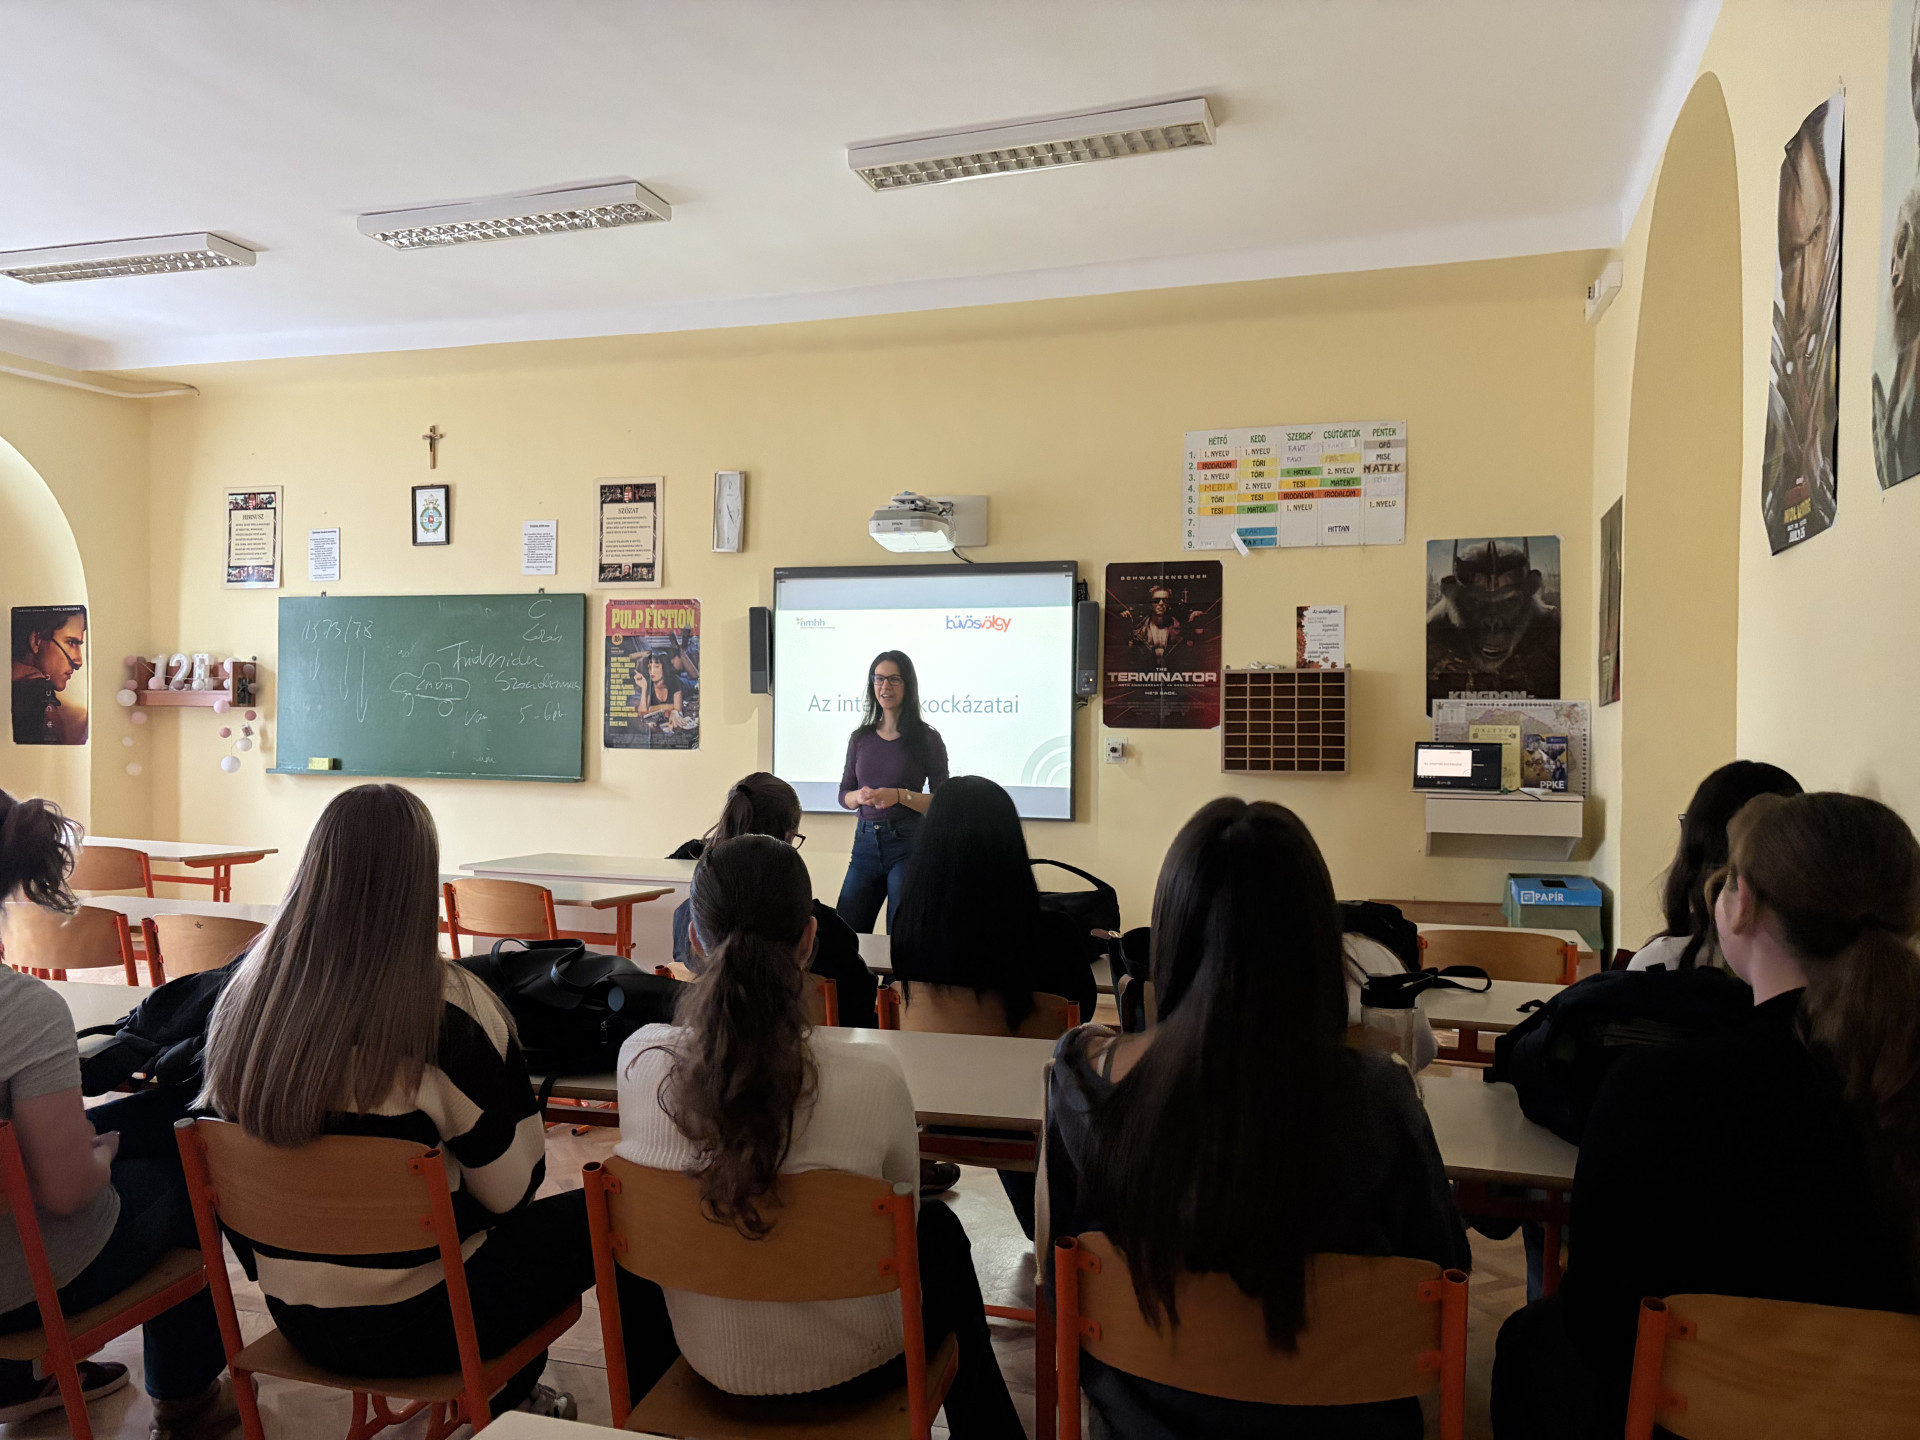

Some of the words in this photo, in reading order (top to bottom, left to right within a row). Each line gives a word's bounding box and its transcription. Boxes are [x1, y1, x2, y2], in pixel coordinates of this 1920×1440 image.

[1372, 426, 1396, 437] PÉNTEK
[1250, 434, 1266, 443] KEDD
[1287, 432, 1312, 441] SZERDA
[1189, 451, 1196, 459] 1.
[1202, 462, 1232, 470] IRODALOM
[1363, 464, 1400, 473] MATEK
[611, 608, 643, 629] PULP
[645, 608, 695, 629] FICTION
[1107, 672, 1216, 682] TERMINATOR
[1448, 691, 1527, 699] KINGDOM
[808, 694, 831, 712] Az
[1540, 780, 1565, 789] PPKE
[1535, 891, 1564, 901] PAPÍR
